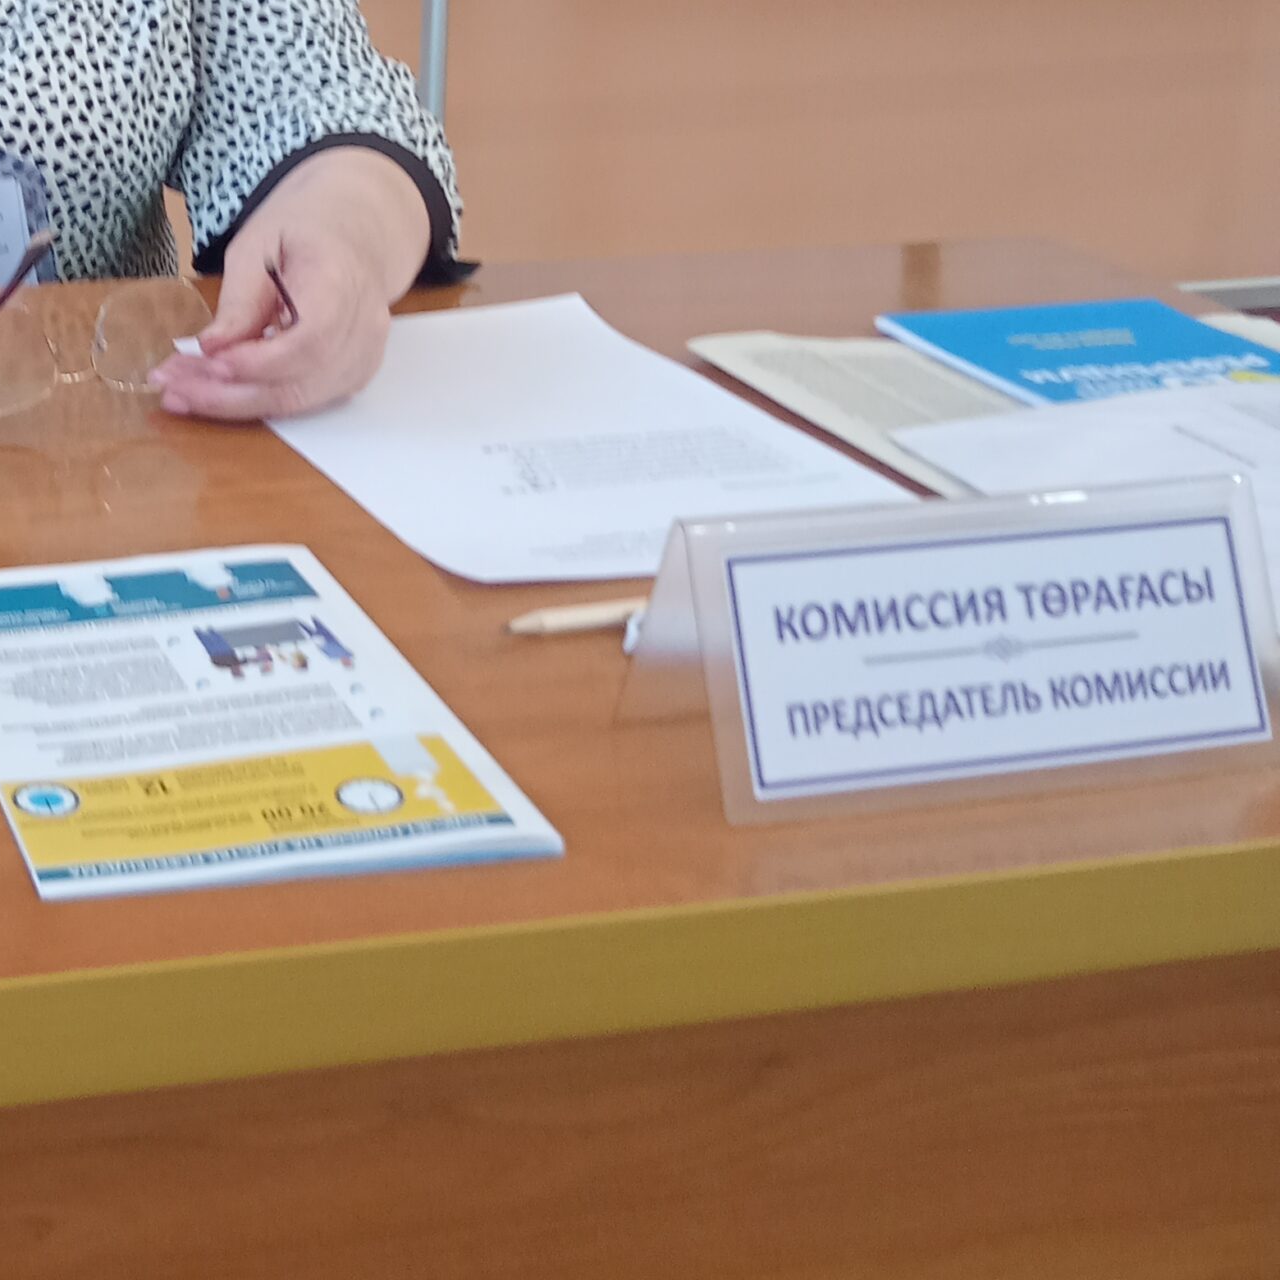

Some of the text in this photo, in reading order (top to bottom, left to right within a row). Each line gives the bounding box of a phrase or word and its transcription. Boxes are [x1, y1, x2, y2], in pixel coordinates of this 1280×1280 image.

[773, 565, 1216, 645] КОМИССИЯ ТӨРАҒАСЫ
[787, 658, 1232, 739] ПРЕДСЕДАТЕЛЬ КОМИССИИ
